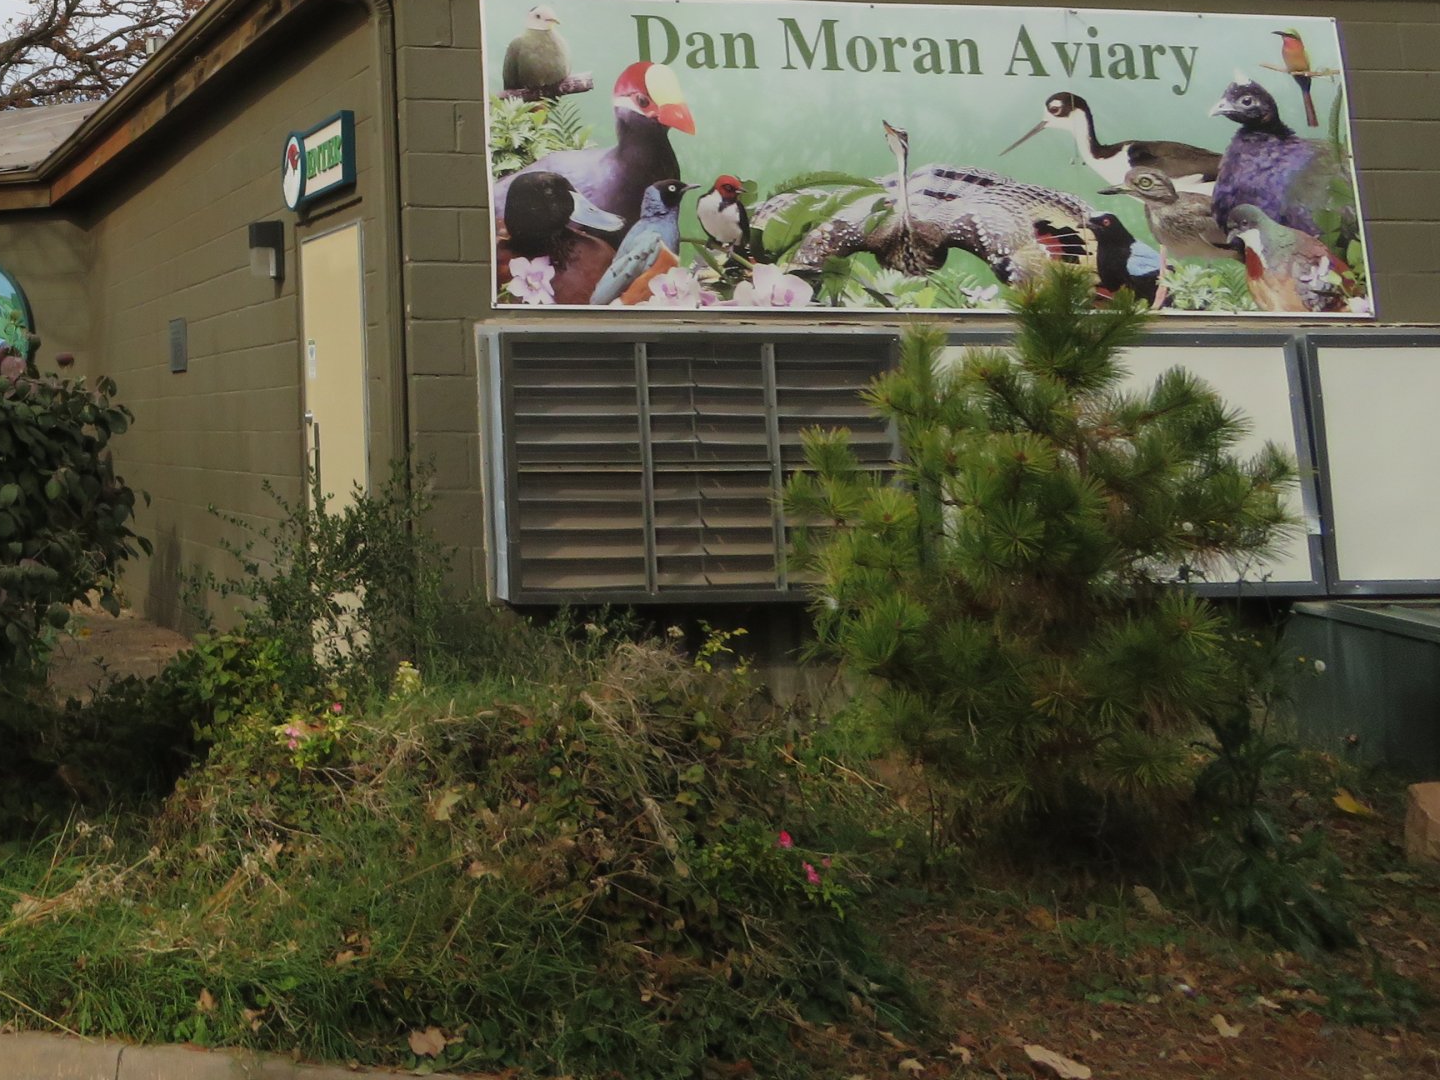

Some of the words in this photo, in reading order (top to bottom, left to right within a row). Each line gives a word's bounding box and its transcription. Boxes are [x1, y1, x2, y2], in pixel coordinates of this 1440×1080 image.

[631, 14, 760, 70] Dan
[777, 17, 984, 76] Moran
[1004, 23, 1199, 96] Aviary
